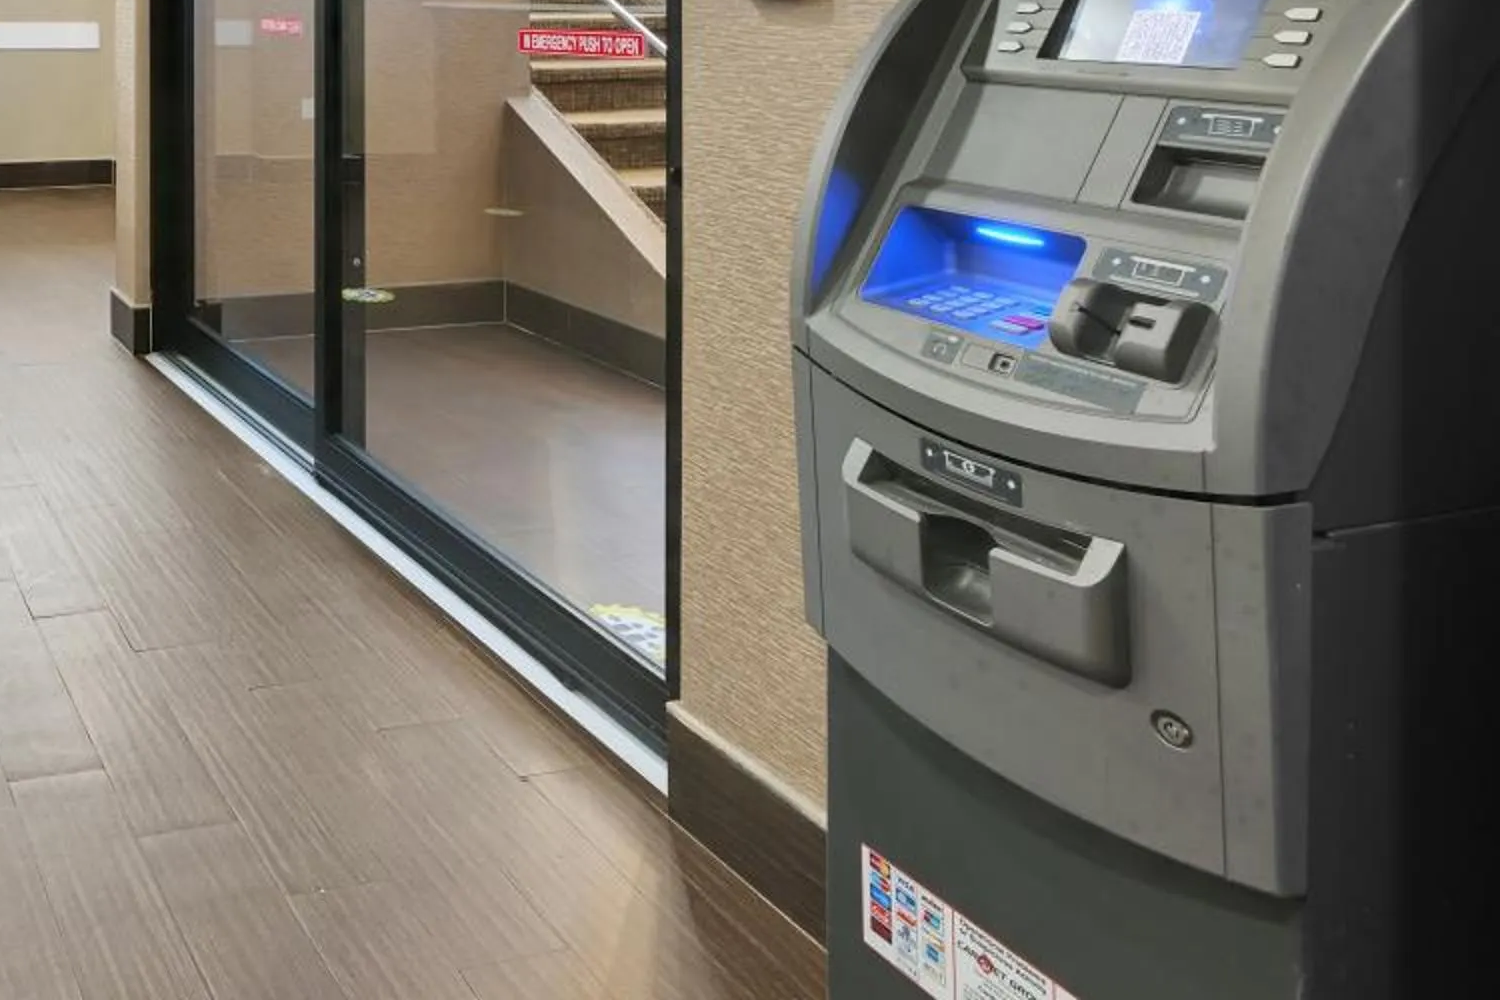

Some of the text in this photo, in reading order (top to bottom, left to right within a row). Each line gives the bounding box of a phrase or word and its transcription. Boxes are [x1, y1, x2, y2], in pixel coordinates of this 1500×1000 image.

[531, 33, 577, 51] EMERGENCY
[578, 35, 601, 53] PUSH
[601, 36, 614, 54] TO
[614, 36, 640, 55] OPEN
